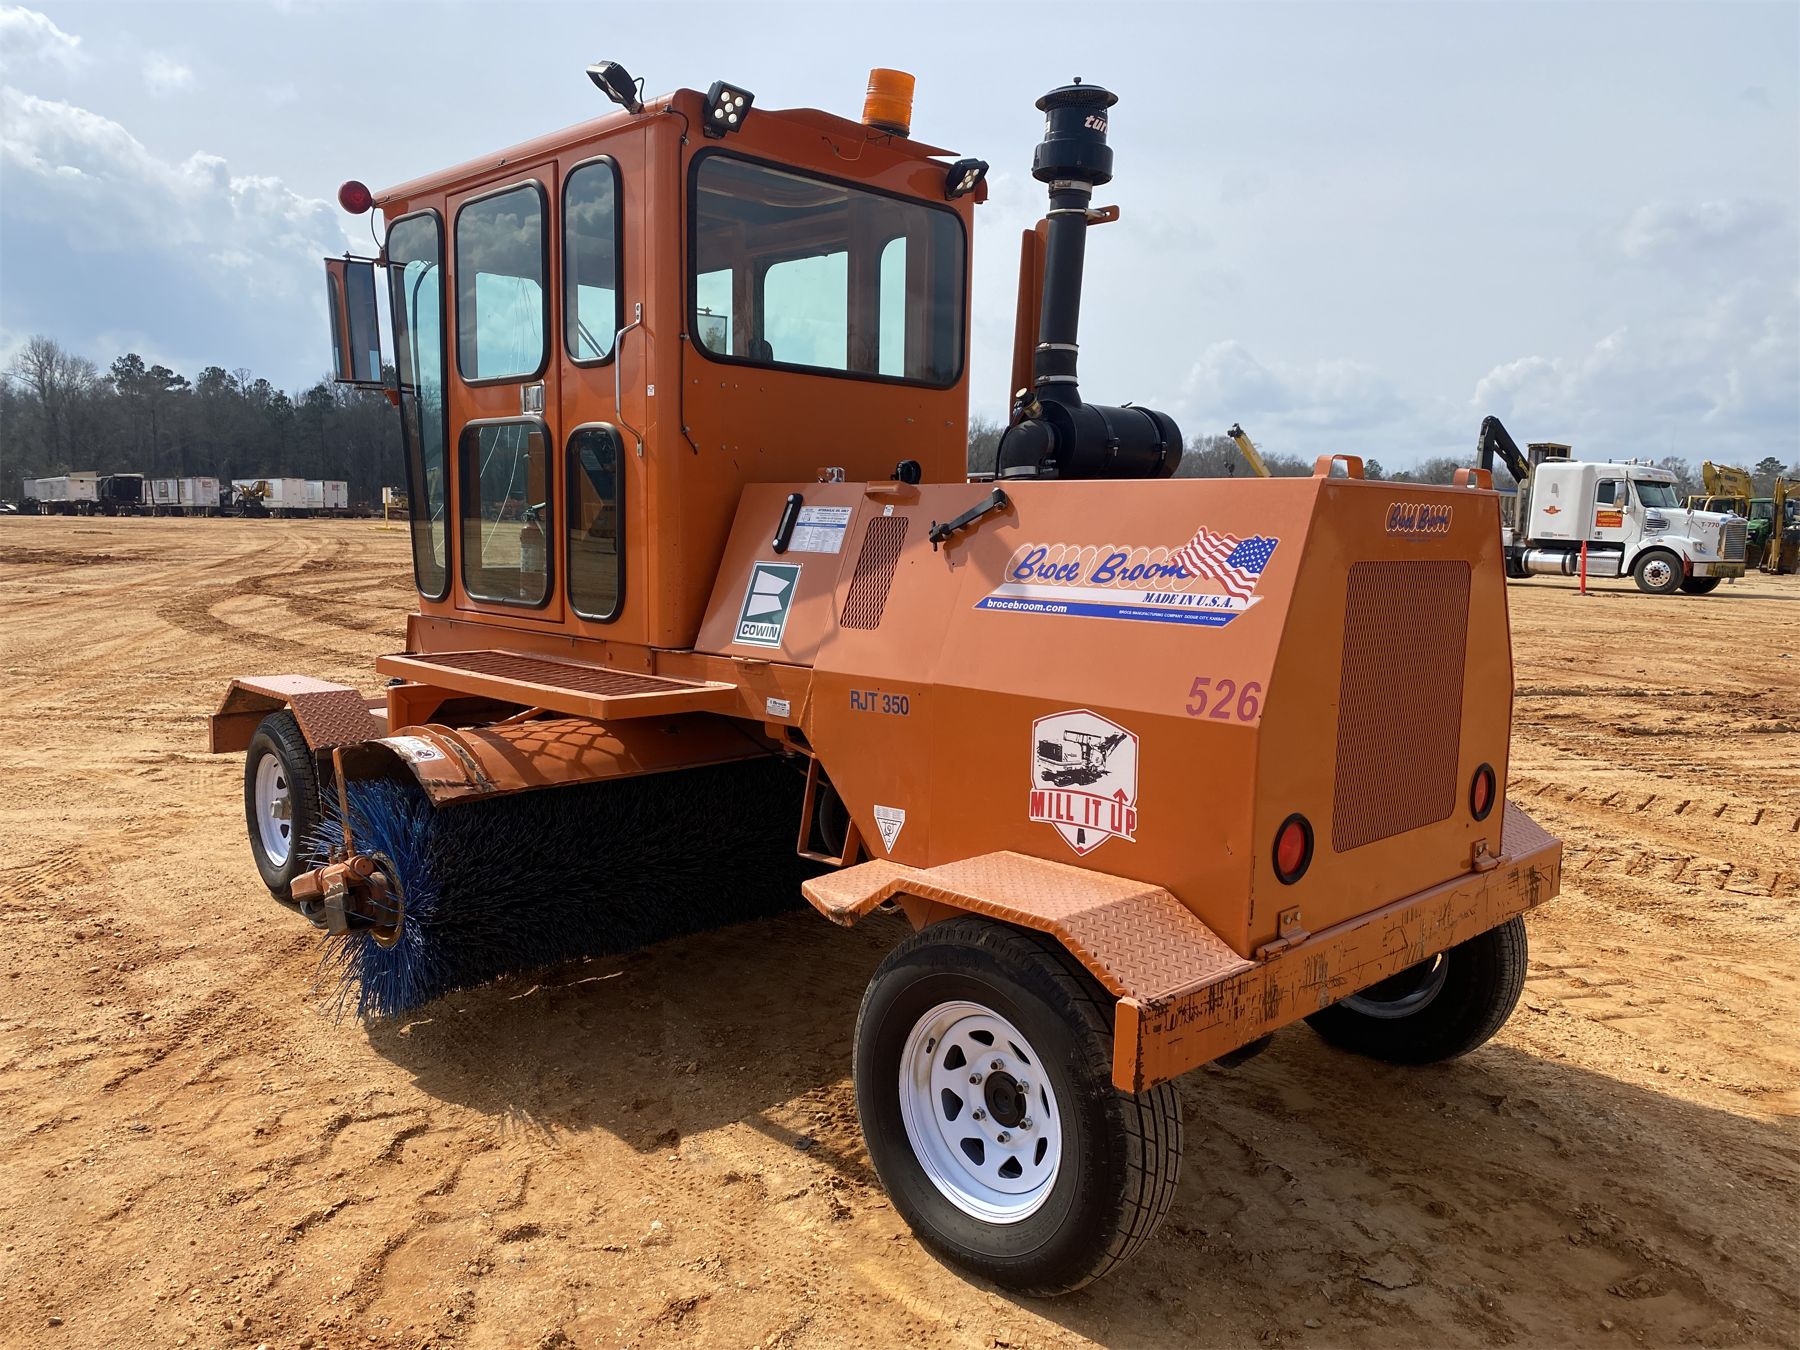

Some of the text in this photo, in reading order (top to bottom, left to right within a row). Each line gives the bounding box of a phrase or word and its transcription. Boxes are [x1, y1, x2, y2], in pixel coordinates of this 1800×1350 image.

[1084, 115, 1108, 135] tur
[1013, 547, 1192, 584] Broce Broom
[986, 598, 1068, 613] brocebroom.com
[1142, 592, 1233, 608] MADE IN U.S.A.
[741, 623, 778, 638] COWIN
[850, 690, 910, 715] RJT 350
[1185, 676, 1262, 721] 526
[1030, 791, 1136, 836] MILL IT UP
